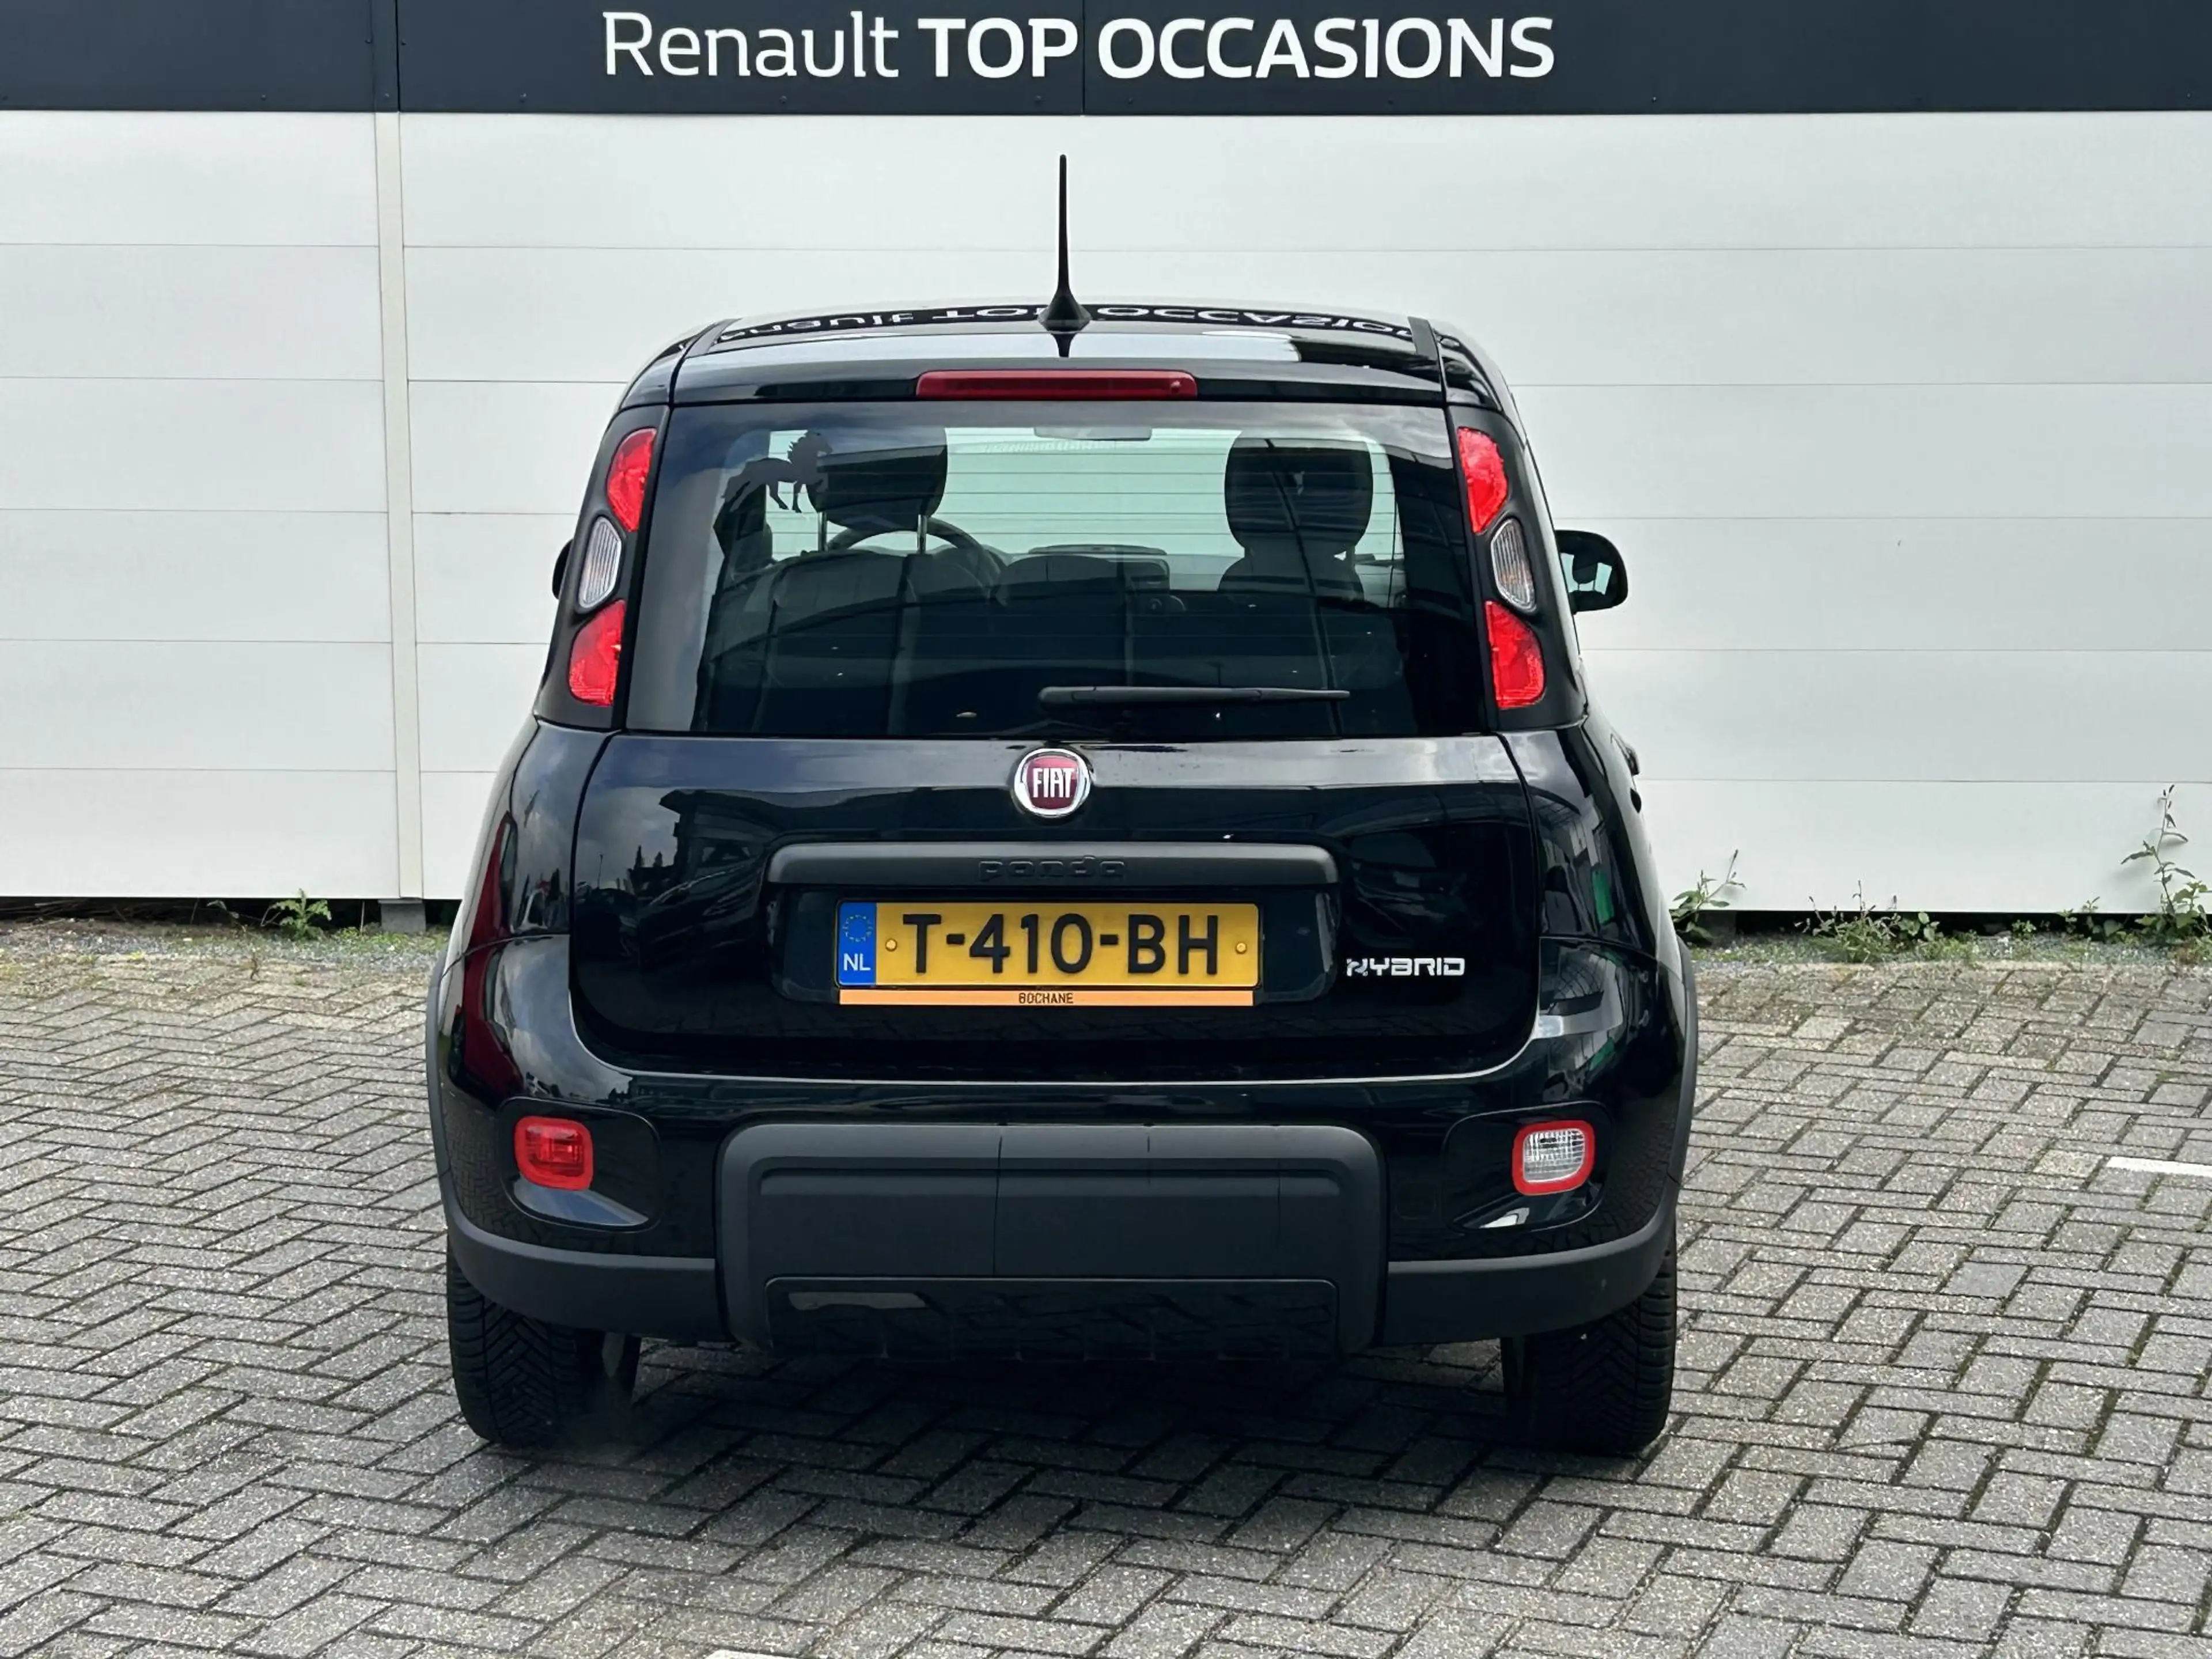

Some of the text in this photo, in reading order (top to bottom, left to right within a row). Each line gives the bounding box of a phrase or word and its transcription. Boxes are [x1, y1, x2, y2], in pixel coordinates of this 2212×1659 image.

[602, 10, 1555, 79] Renault TOP OCCASIONS
[1032, 767, 1075, 798] FIAT
[902, 912, 1219, 975] T-410-BH
[843, 952, 872, 971] NL
[1346, 957, 1466, 977] HYBRID
[1018, 992, 1074, 1004] BOCHANE
